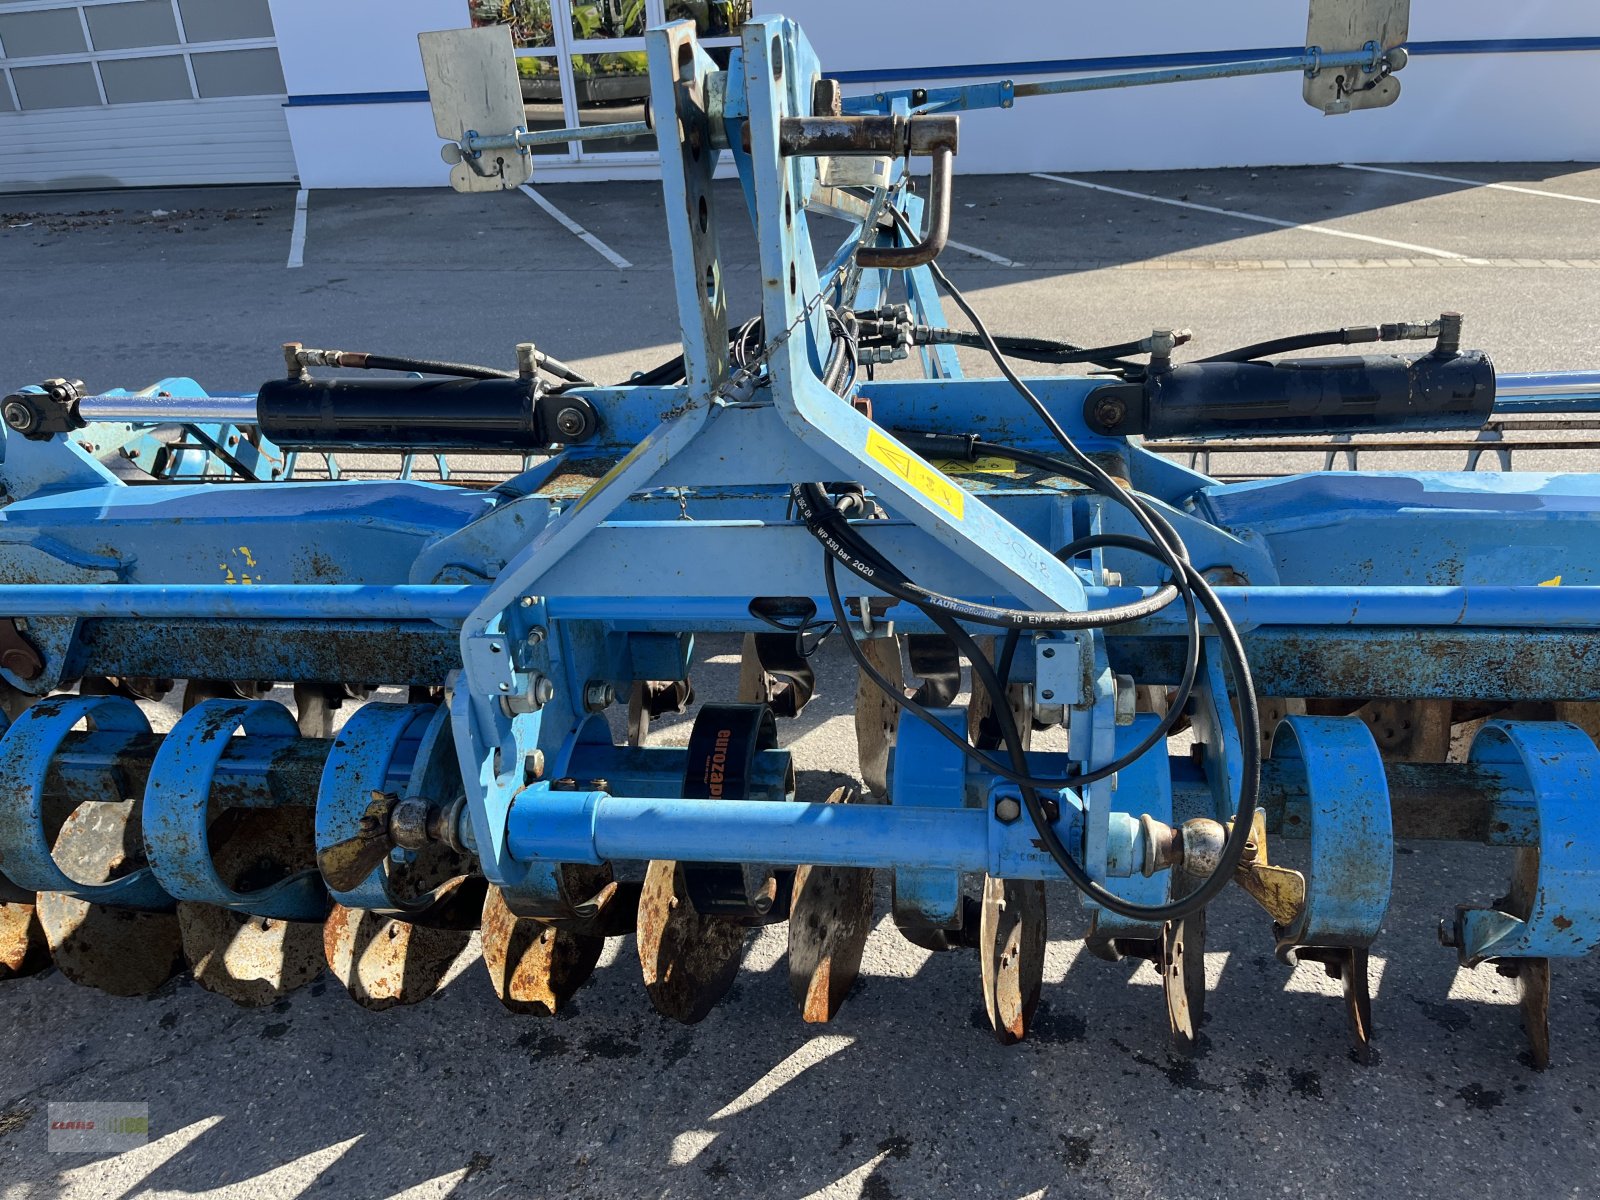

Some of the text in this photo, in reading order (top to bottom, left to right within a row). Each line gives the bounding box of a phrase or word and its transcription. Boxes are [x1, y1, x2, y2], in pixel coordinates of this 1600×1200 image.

[817, 527, 828, 539] WP
[826, 538, 839, 551] 330
[837, 548, 851, 561] bar
[852, 560, 874, 577] 2Q20
[1012, 615, 1023, 623] 10
[1028, 616, 1042, 624] EN
